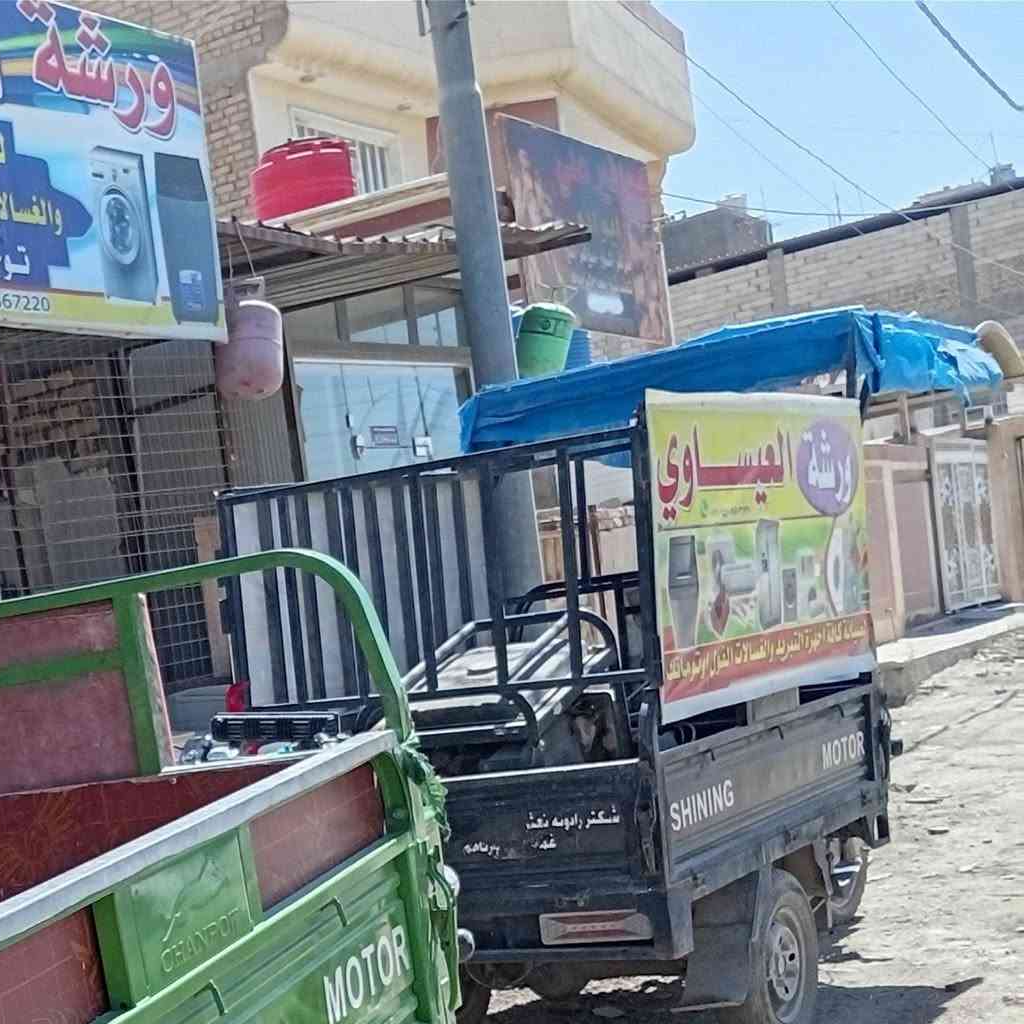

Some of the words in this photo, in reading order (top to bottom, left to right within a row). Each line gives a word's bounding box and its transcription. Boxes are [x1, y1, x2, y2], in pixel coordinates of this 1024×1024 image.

[17, 0, 176, 138] ورشة
[657, 424, 793, 521] العيساوي
[669, 779, 735, 832] SHINING
[822, 731, 865, 769] MOTOR
